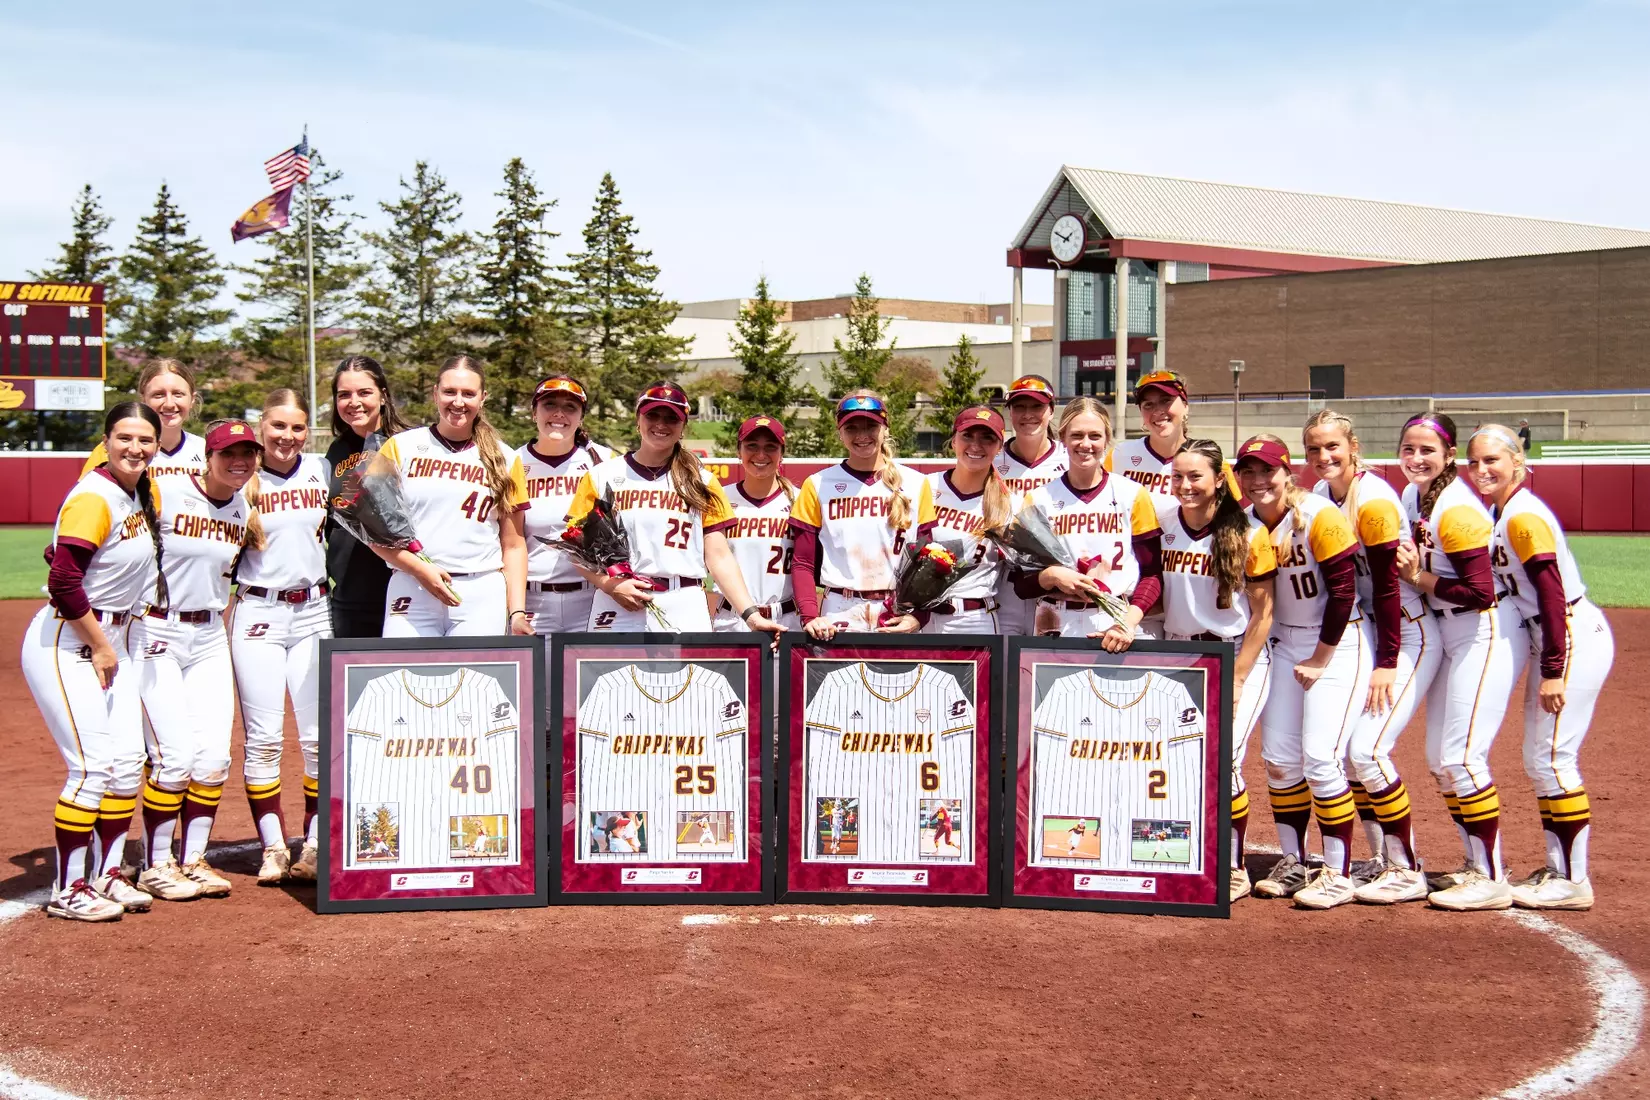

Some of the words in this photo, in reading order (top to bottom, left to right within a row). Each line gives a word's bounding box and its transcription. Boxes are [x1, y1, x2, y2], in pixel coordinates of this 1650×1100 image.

[17, 284, 93, 302] SOFTBALL
[4, 304, 28, 316] OUT
[27, 334, 53, 346] RUNS
[256, 488, 327, 515] HIPPEWAS
[461, 491, 495, 523] 40
[828, 496, 891, 521] CHIPPEW
[664, 518, 692, 550] 25
[1111, 541, 1124, 571] 2
[1290, 570, 1318, 600] 10
[384, 737, 478, 758] CHIPPEWAS
[613, 734, 705, 757] CHIPPEWAS
[841, 732, 934, 753] CHIPPEWAS
[1069, 739, 1163, 761] CHIPPEWAS
[450, 764, 492, 794] 40
[675, 764, 716, 795] 25
[920, 761, 940, 792] 6
[1148, 769, 1168, 800] 2
